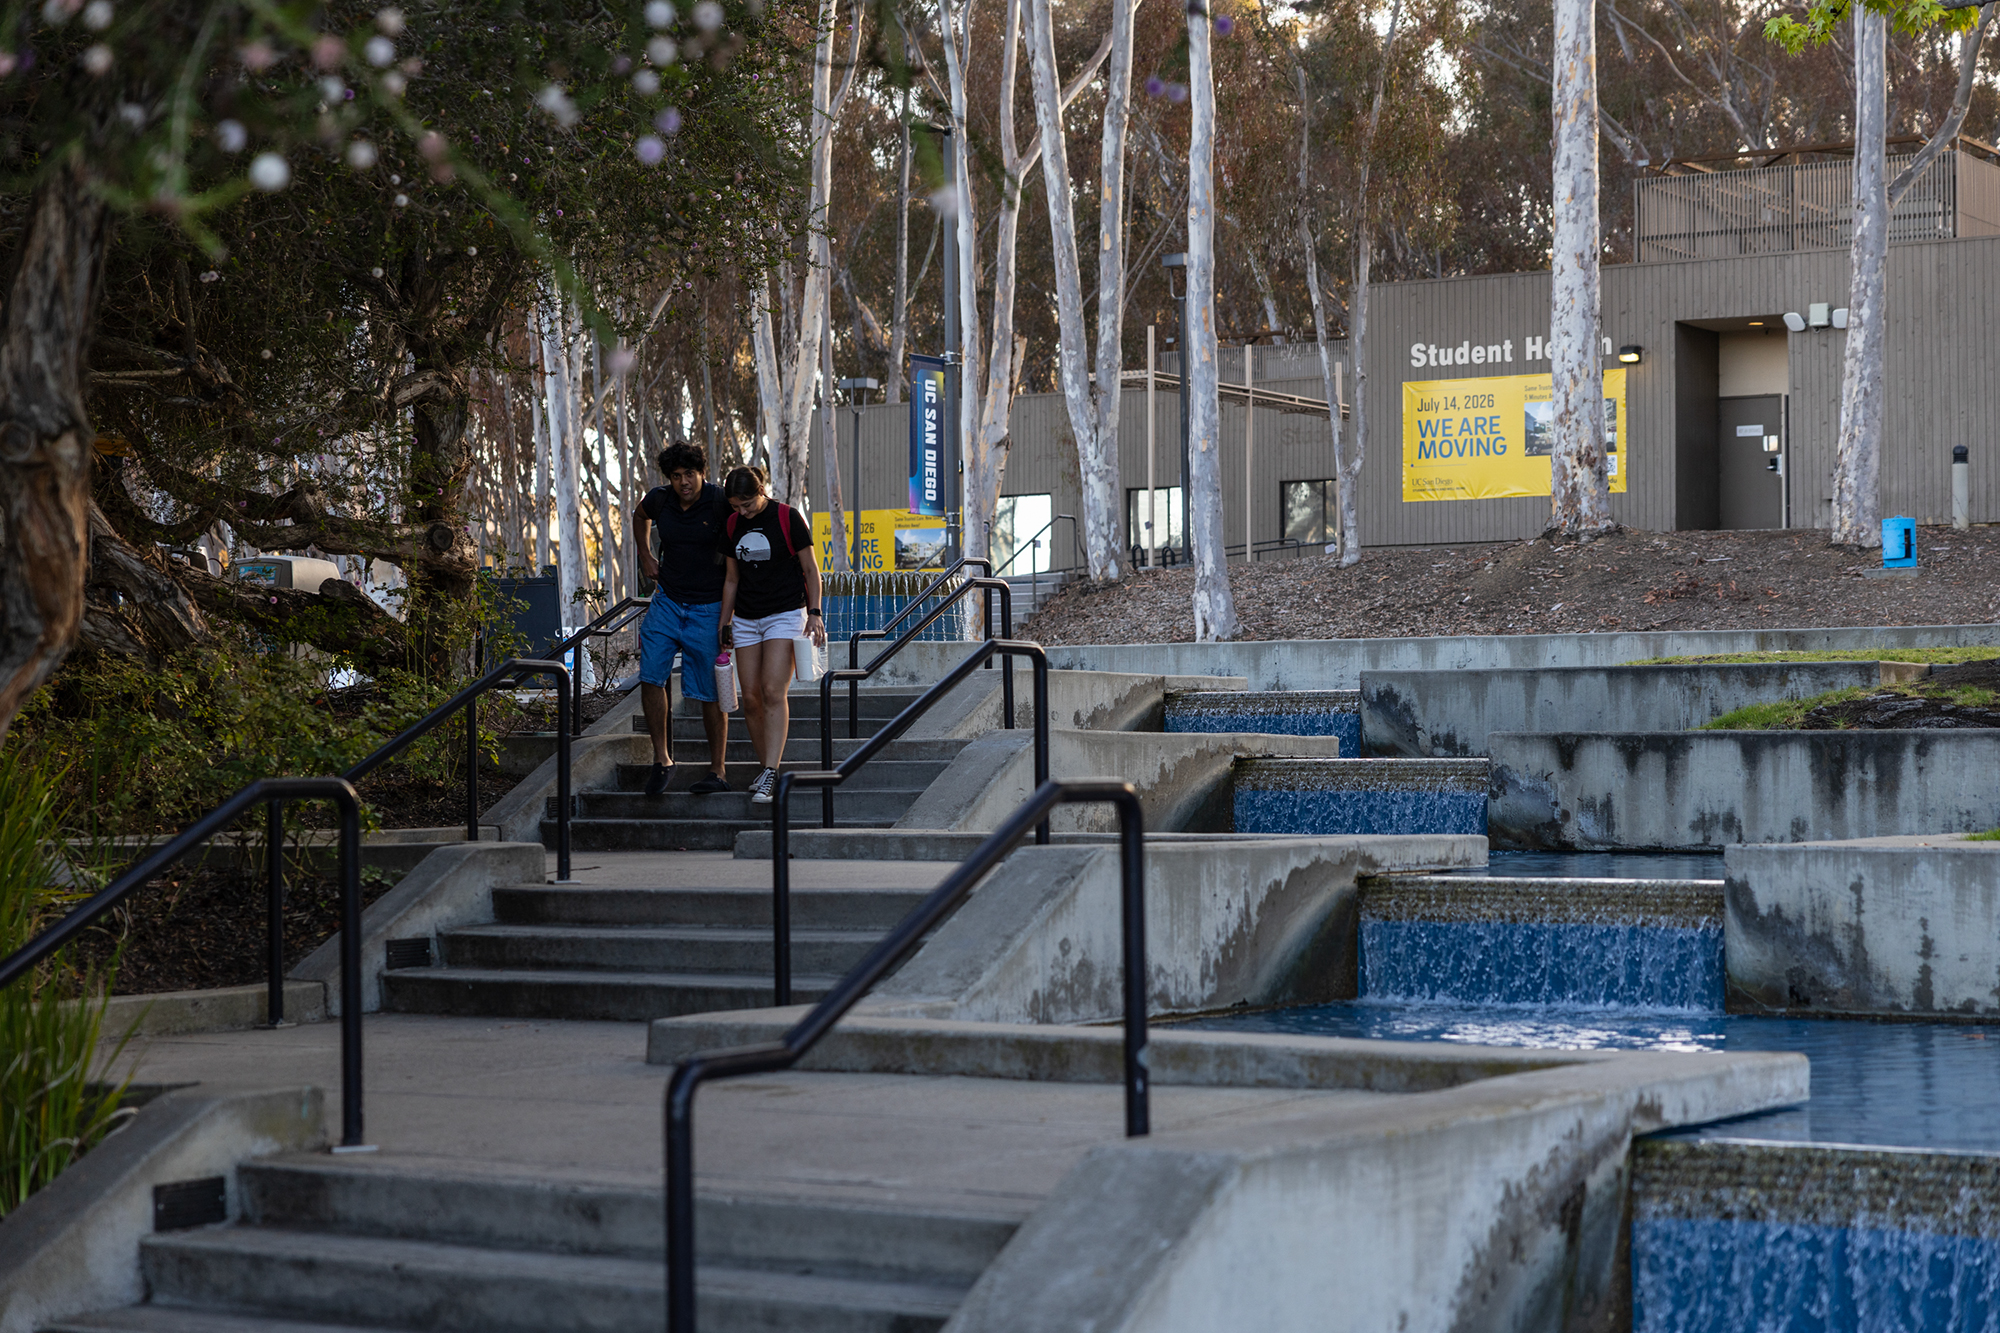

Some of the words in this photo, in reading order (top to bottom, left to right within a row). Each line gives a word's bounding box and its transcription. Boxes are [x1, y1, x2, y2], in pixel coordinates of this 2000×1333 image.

[1410, 340, 1513, 368] Student
[925, 379, 937, 404] UC
[1417, 396, 1440, 414] July
[1443, 395, 1460, 412] 14,
[1464, 393, 1495, 410] 2026
[925, 408, 937, 445] SAN
[1417, 418, 1453, 439] WE
[1458, 415, 1501, 437] ARE
[1418, 436, 1508, 460] MOVING
[925, 449, 937, 502] DIEGO
[1411, 478, 1421, 486] UC
[1422, 477, 1434, 486] San
[1435, 477, 1453, 486] Diego
